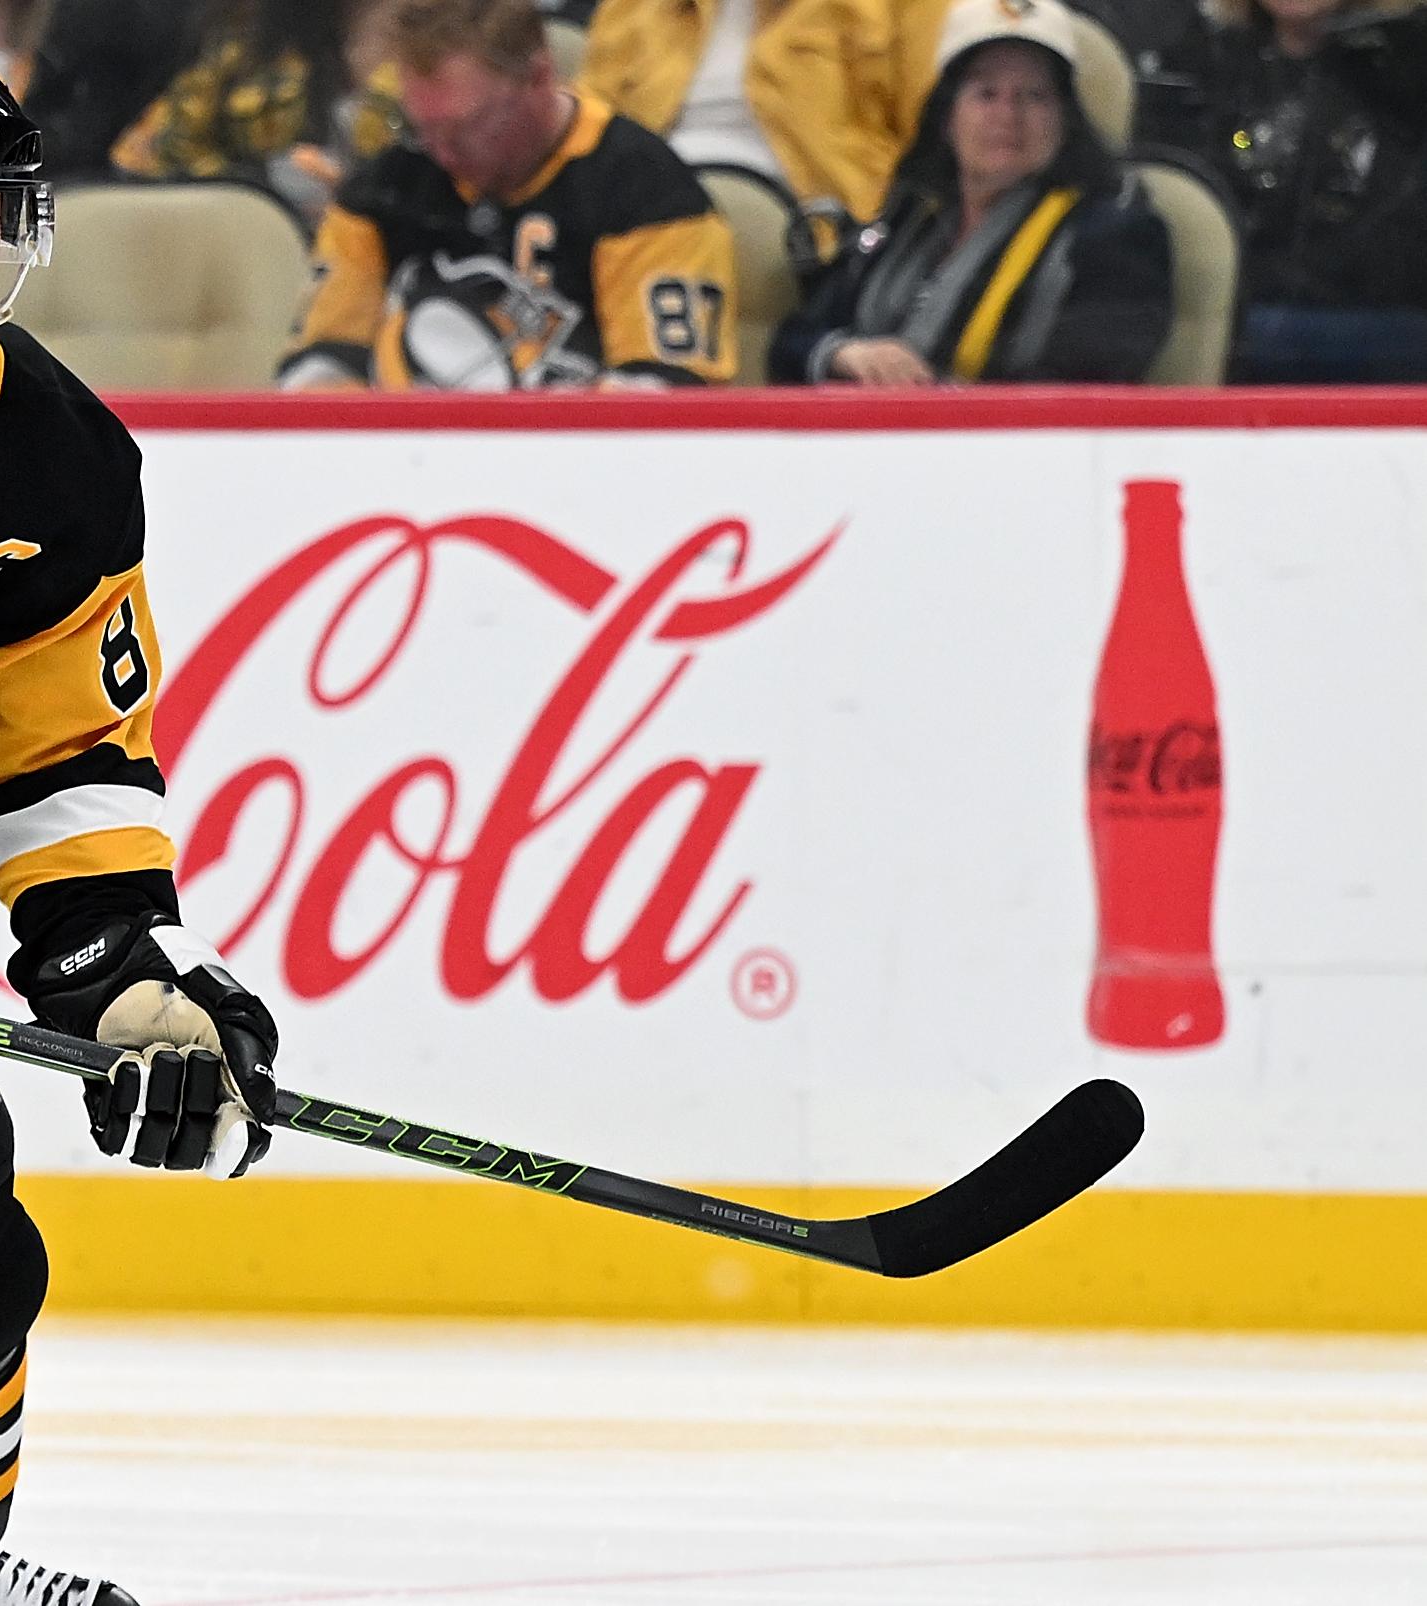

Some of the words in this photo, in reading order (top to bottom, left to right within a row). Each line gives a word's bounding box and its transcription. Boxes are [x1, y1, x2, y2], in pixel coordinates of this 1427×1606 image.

[514, 211, 557, 288] C
[648, 280, 726, 363] 87
[60, 937, 106, 972] CCM
[290, 1093, 589, 1195] CCM
[701, 1202, 809, 1238] RIBCORE
